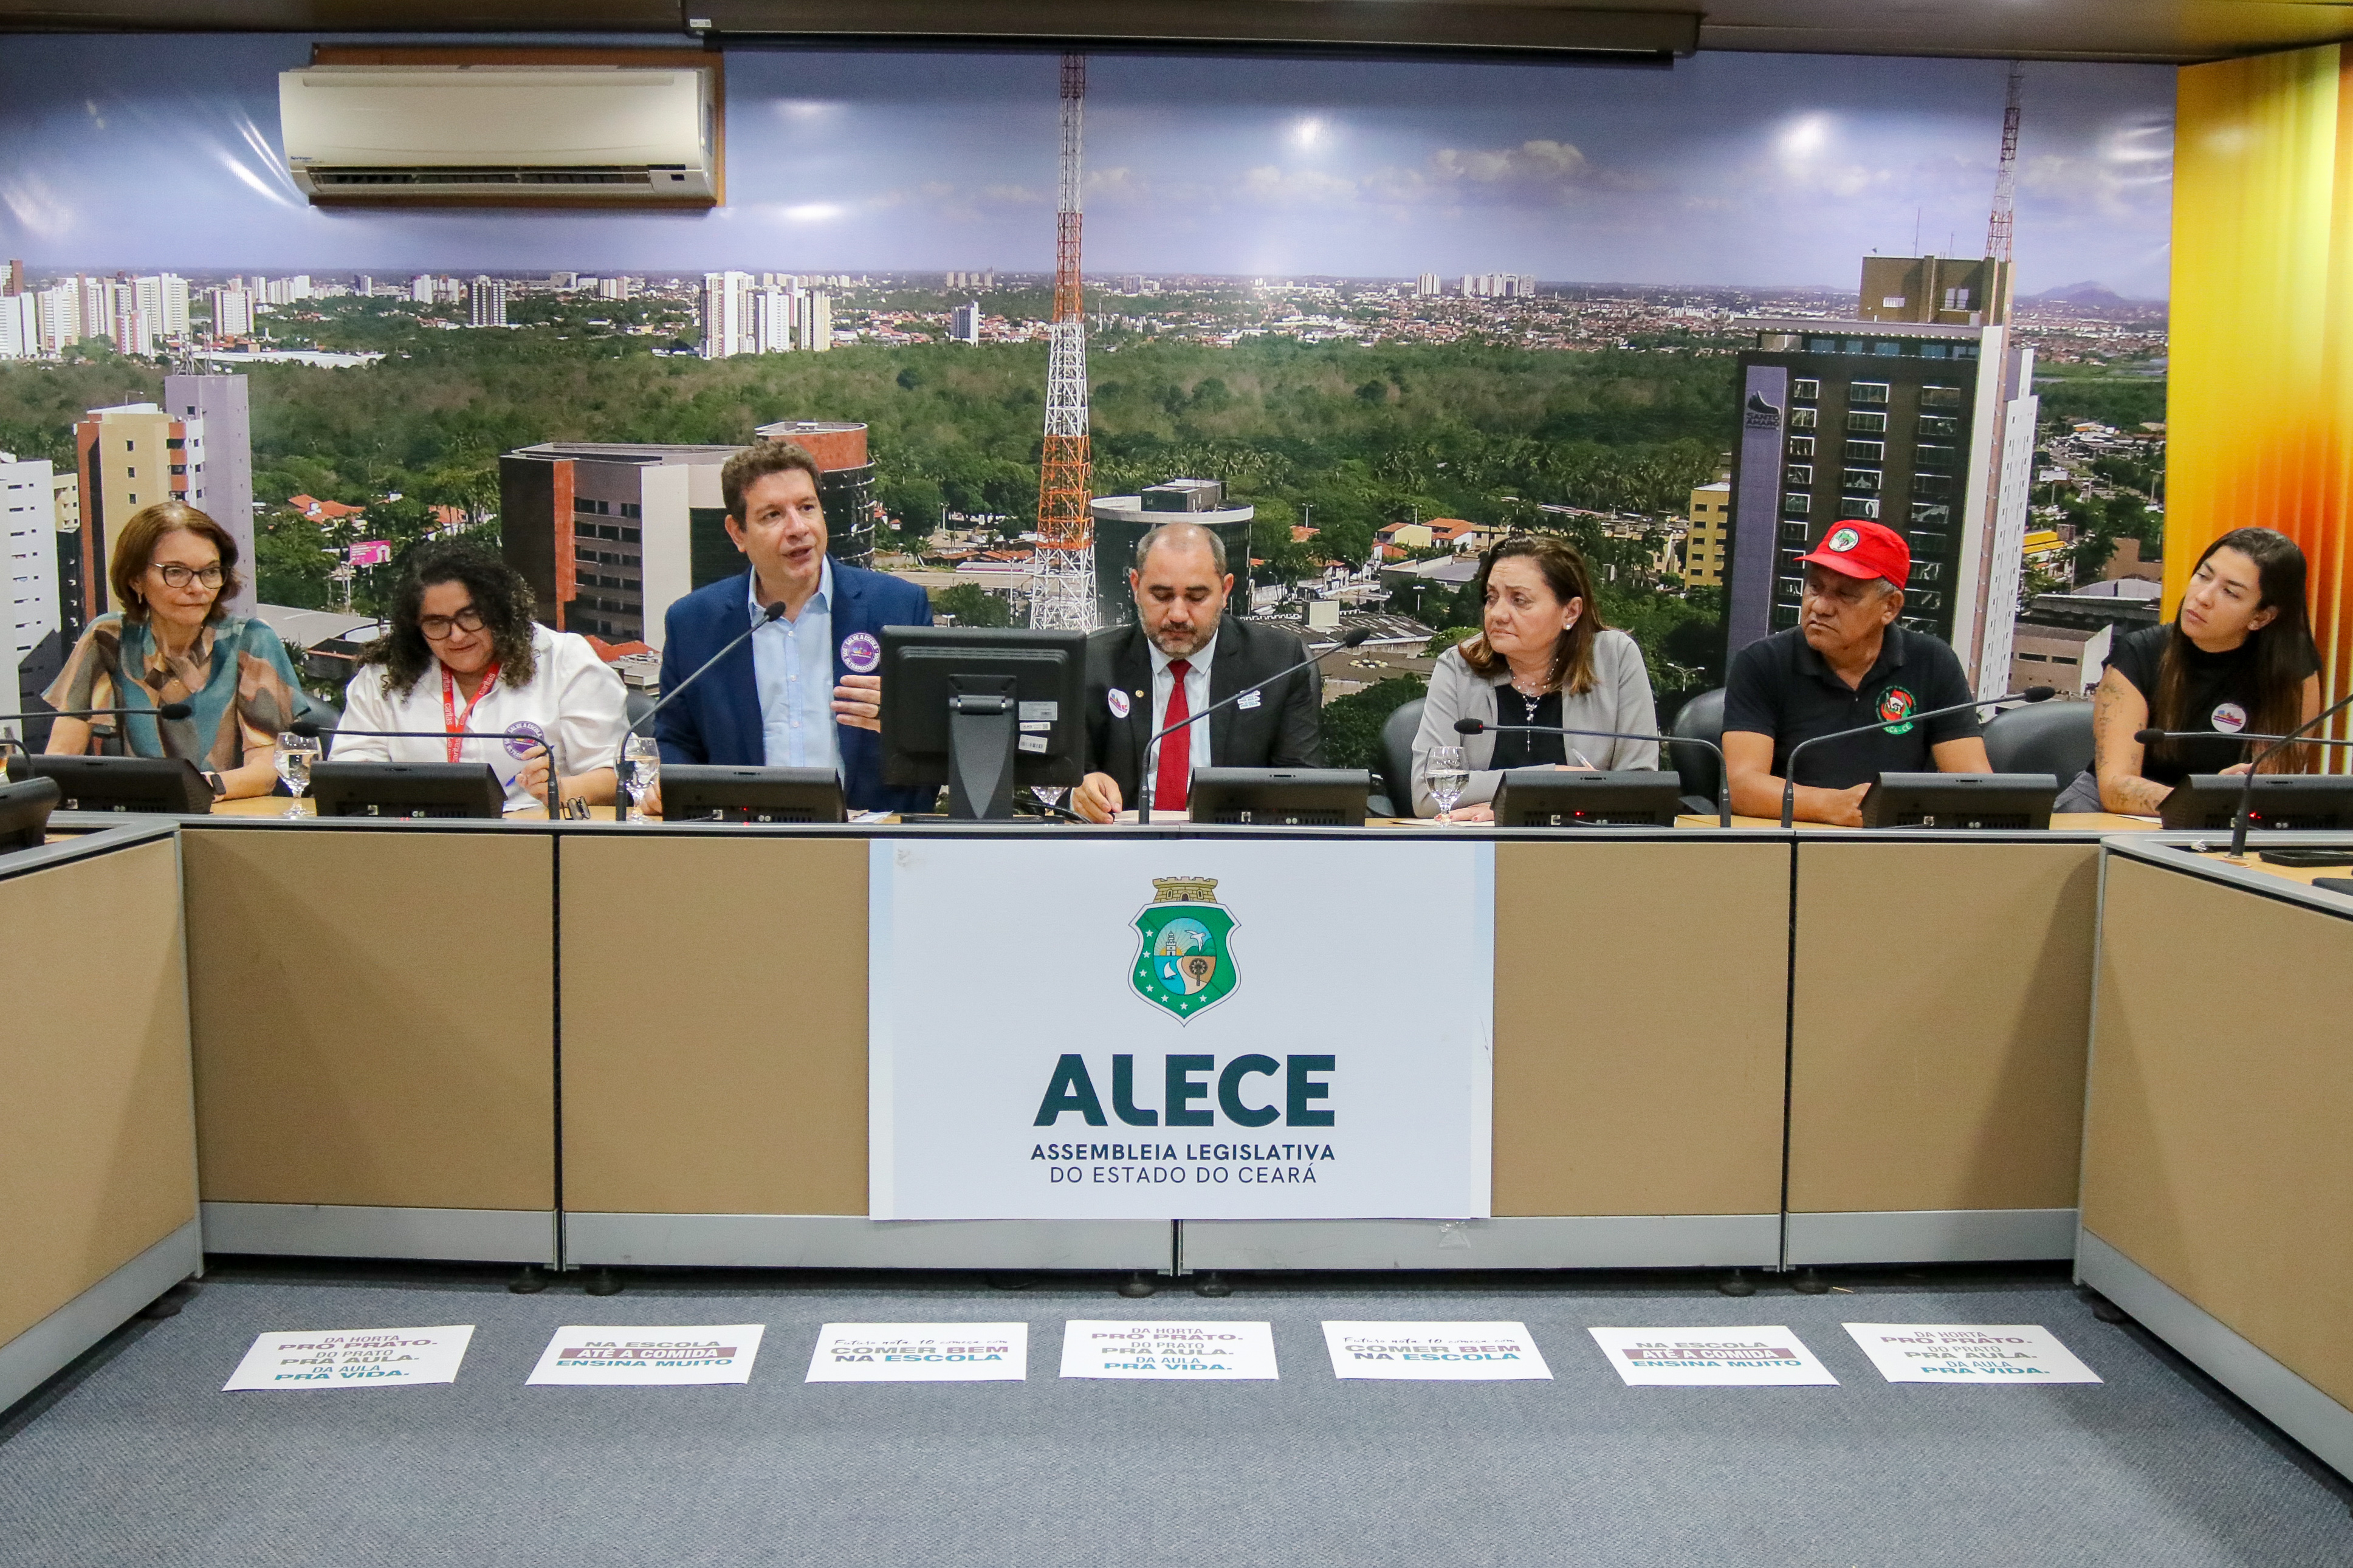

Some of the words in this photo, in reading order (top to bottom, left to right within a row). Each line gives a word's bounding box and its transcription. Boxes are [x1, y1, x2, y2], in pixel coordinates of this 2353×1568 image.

[845, 635, 859, 646] SALVE
[864, 635, 879, 649] ESCOLA
[1032, 1053, 1336, 1128] ALECE
[1031, 1144, 1176, 1161] ASSEMBLEIA
[1186, 1144, 1336, 1161] LEGISLATIVA
[1051, 1166, 1084, 1183] DO
[1093, 1166, 1186, 1183] ESTADO
[1197, 1166, 1229, 1183] DO
[1238, 1162, 1316, 1183] CEARÁ
[343, 1340, 438, 1349] PRATO.
[342, 1355, 419, 1363] AULA.
[577, 1348, 614, 1358] ATÉ
[620, 1349, 634, 1358] A
[640, 1349, 718, 1358] COMIDA
[1643, 1349, 1675, 1358] ATÉ
[1683, 1350, 1697, 1358] A
[1700, 1350, 1779, 1359] COMIDA
